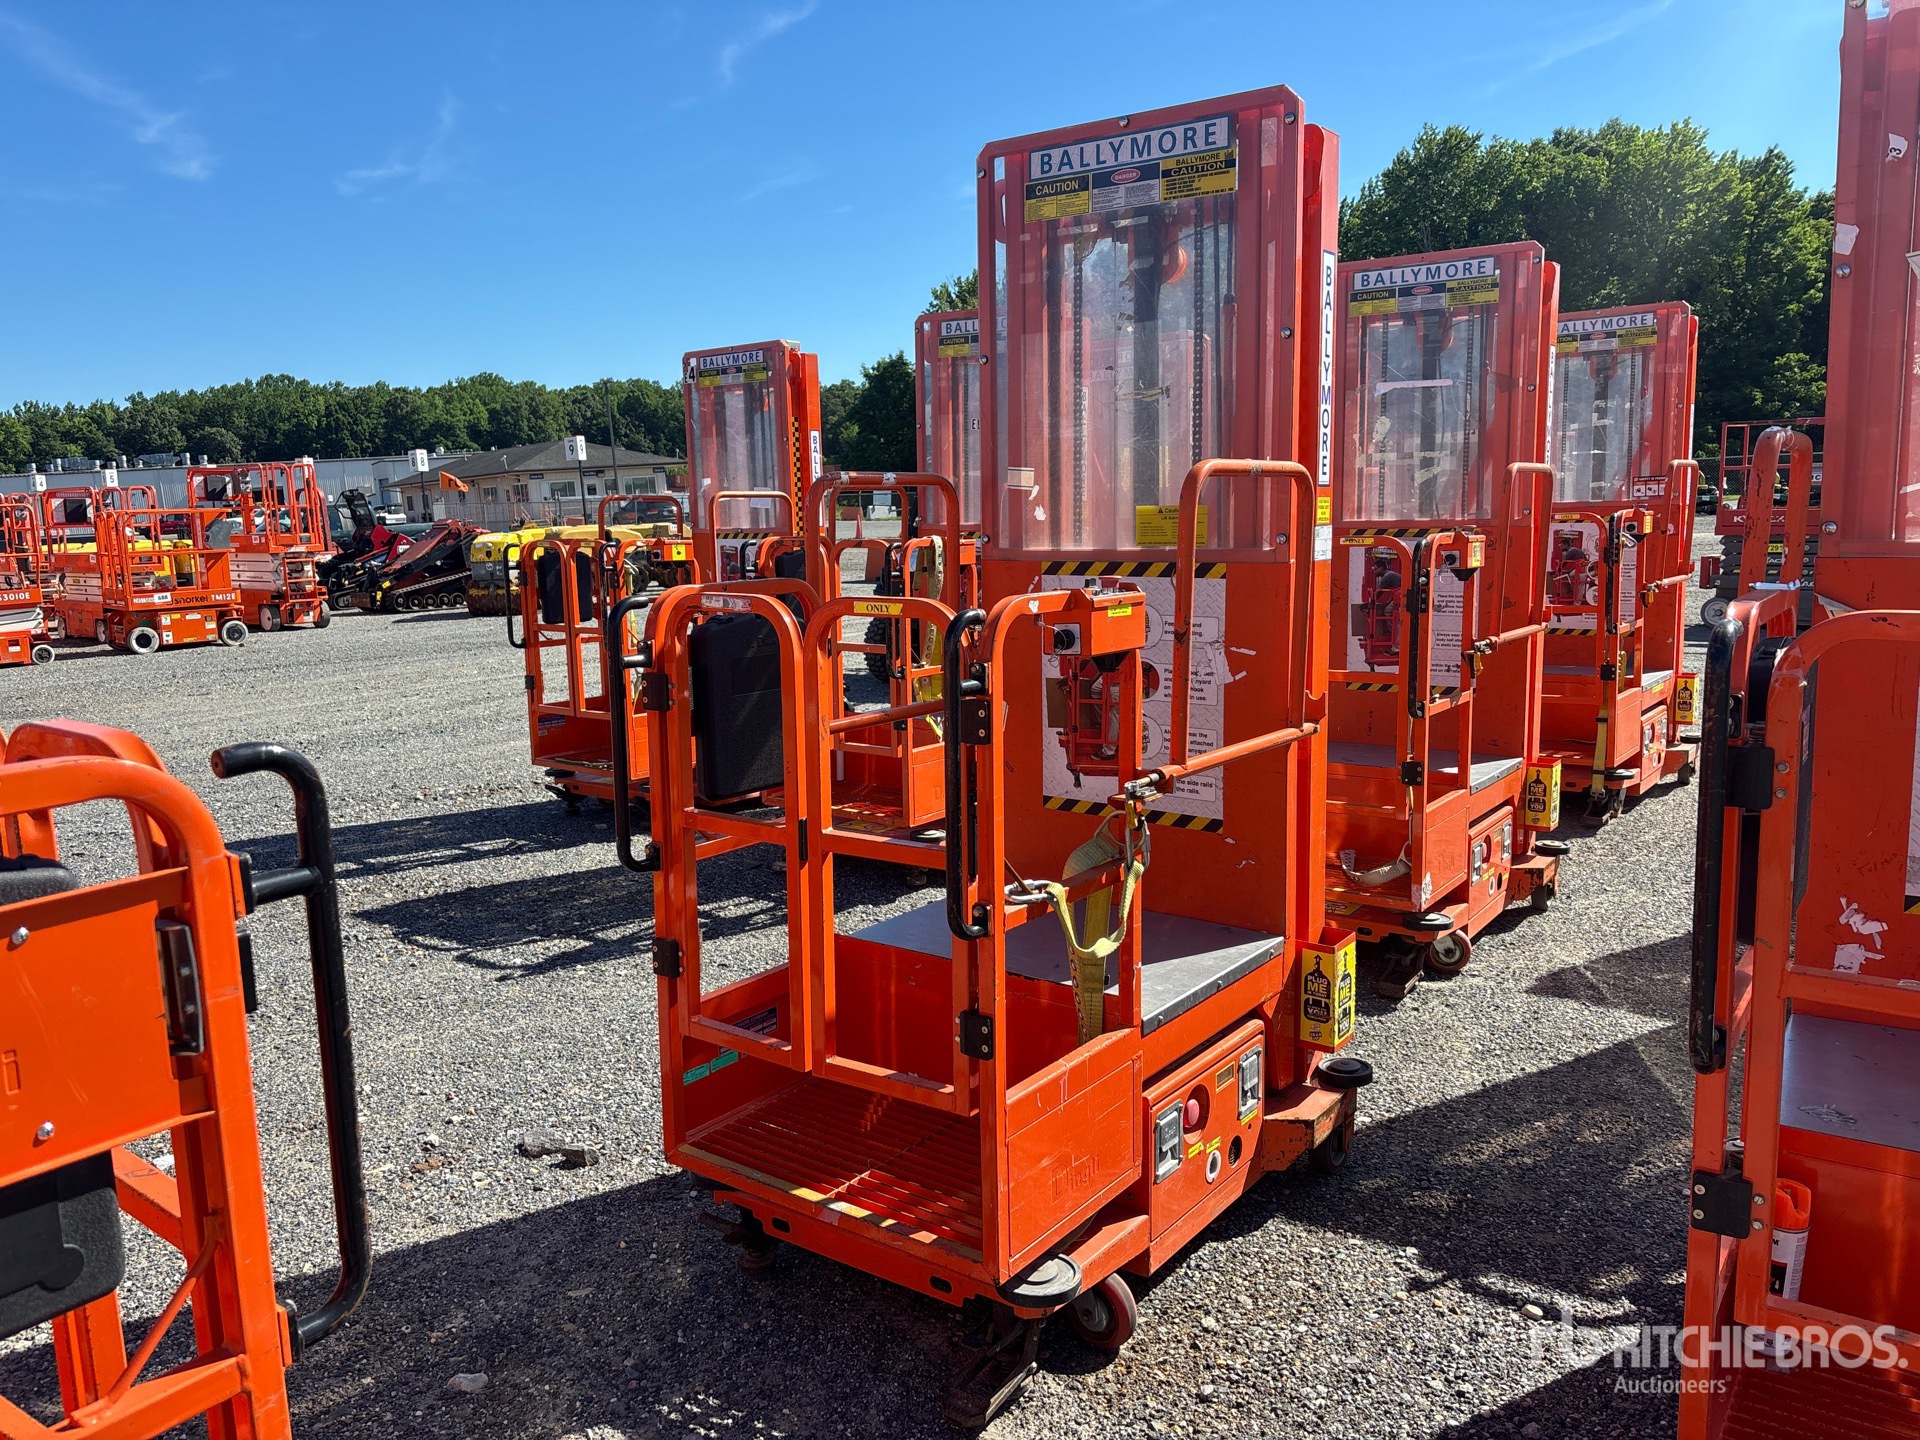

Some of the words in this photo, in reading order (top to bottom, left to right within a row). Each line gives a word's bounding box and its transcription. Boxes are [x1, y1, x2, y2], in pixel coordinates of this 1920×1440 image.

[1040, 122, 1217, 175] BALLYMORE
[1175, 152, 1221, 167] BALLYMORE
[1171, 161, 1226, 176] CAUTION
[1114, 172, 1138, 181] DANGER
[1035, 180, 1079, 196] CAUTION
[1361, 260, 1487, 288] BALLYMORE
[1453, 284, 1492, 292] CAUTION
[1357, 291, 1389, 301] CAUTION
[945, 320, 978, 334] BALL
[1560, 315, 1648, 333] ALLYMORE
[943, 337, 965, 345] CAUTION
[702, 352, 760, 368] BALLYMORE
[1321, 265, 1333, 475] BALLYMORE
[569, 444, 575, 455] 9
[109, 475, 115, 483] 5
[173, 595, 208, 605] snorkel
[211, 593, 236, 601] TM12E
[866, 604, 891, 613] ONLY
[1307, 975, 1328, 984] PLUG
[1307, 981, 1328, 994] ME
[1340, 985, 1350, 999] ME
